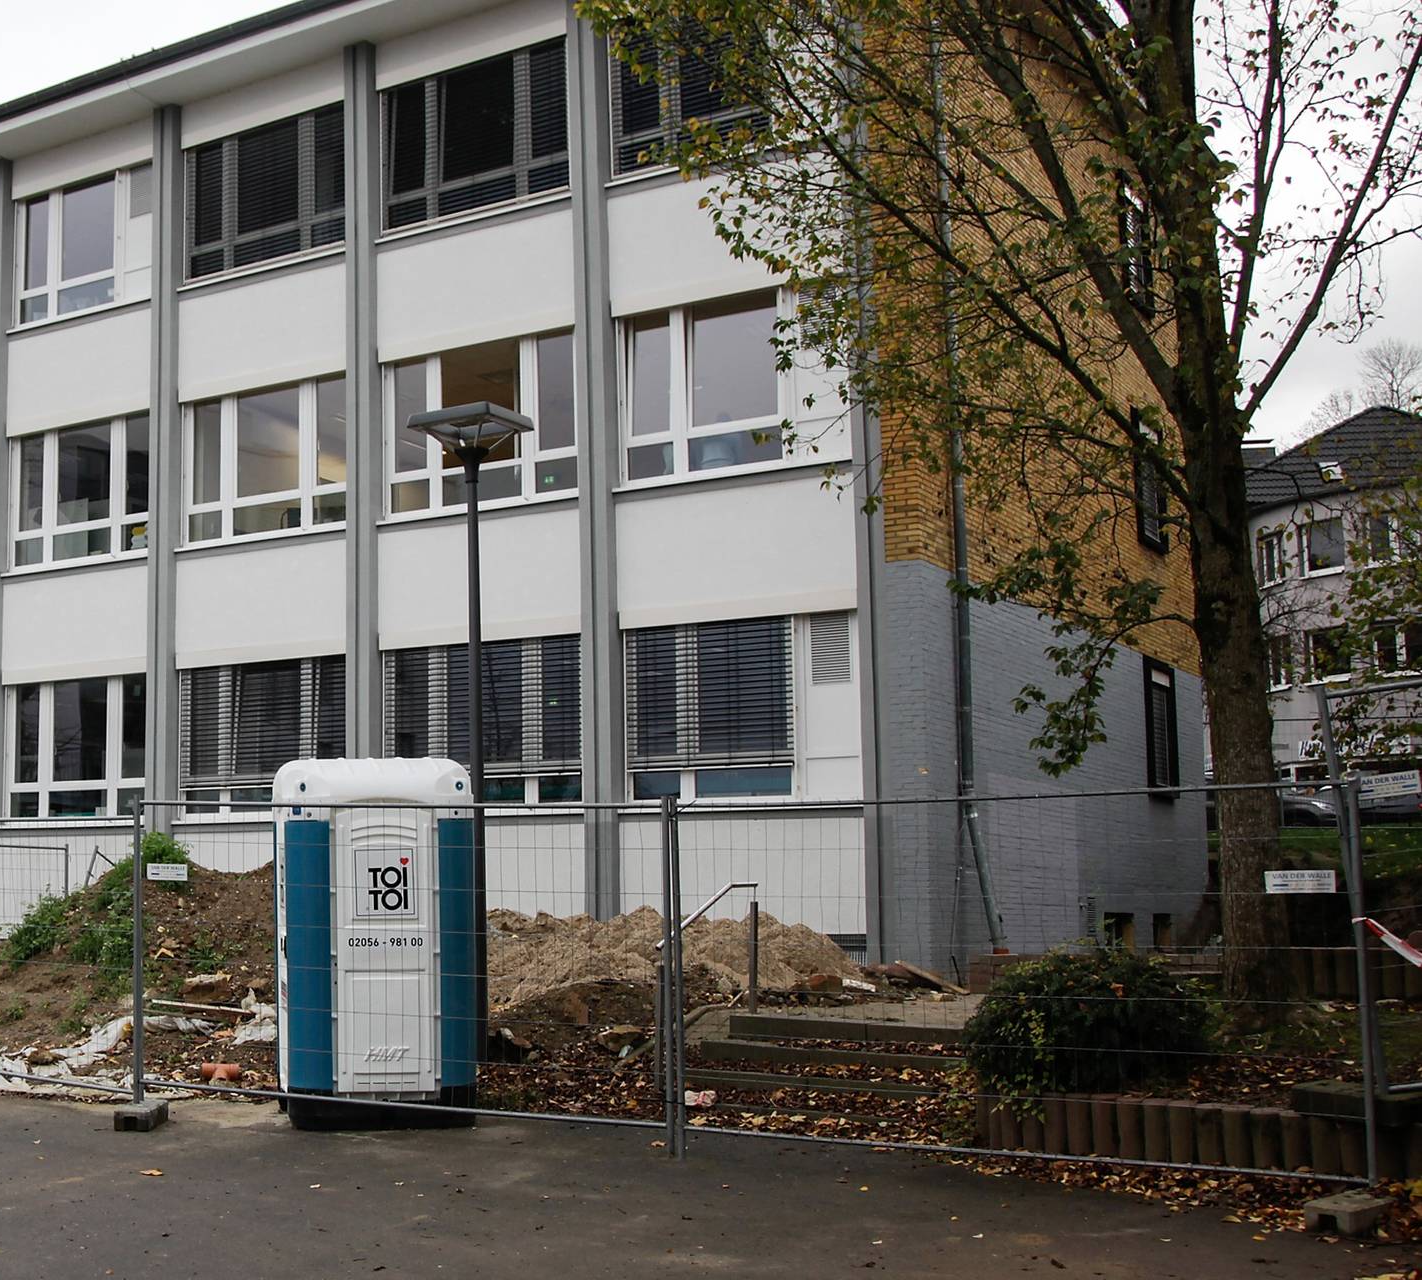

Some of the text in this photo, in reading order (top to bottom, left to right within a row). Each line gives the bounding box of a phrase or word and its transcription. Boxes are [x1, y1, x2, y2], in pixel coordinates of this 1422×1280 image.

[1391, 773, 1416, 782] WALLE
[368, 866, 408, 889] TOI
[1307, 871, 1331, 879] WALLE
[368, 888, 409, 911] TOI
[348, 937, 379, 947] 02056
[389, 937, 407, 947] 981
[410, 937, 423, 947] 00
